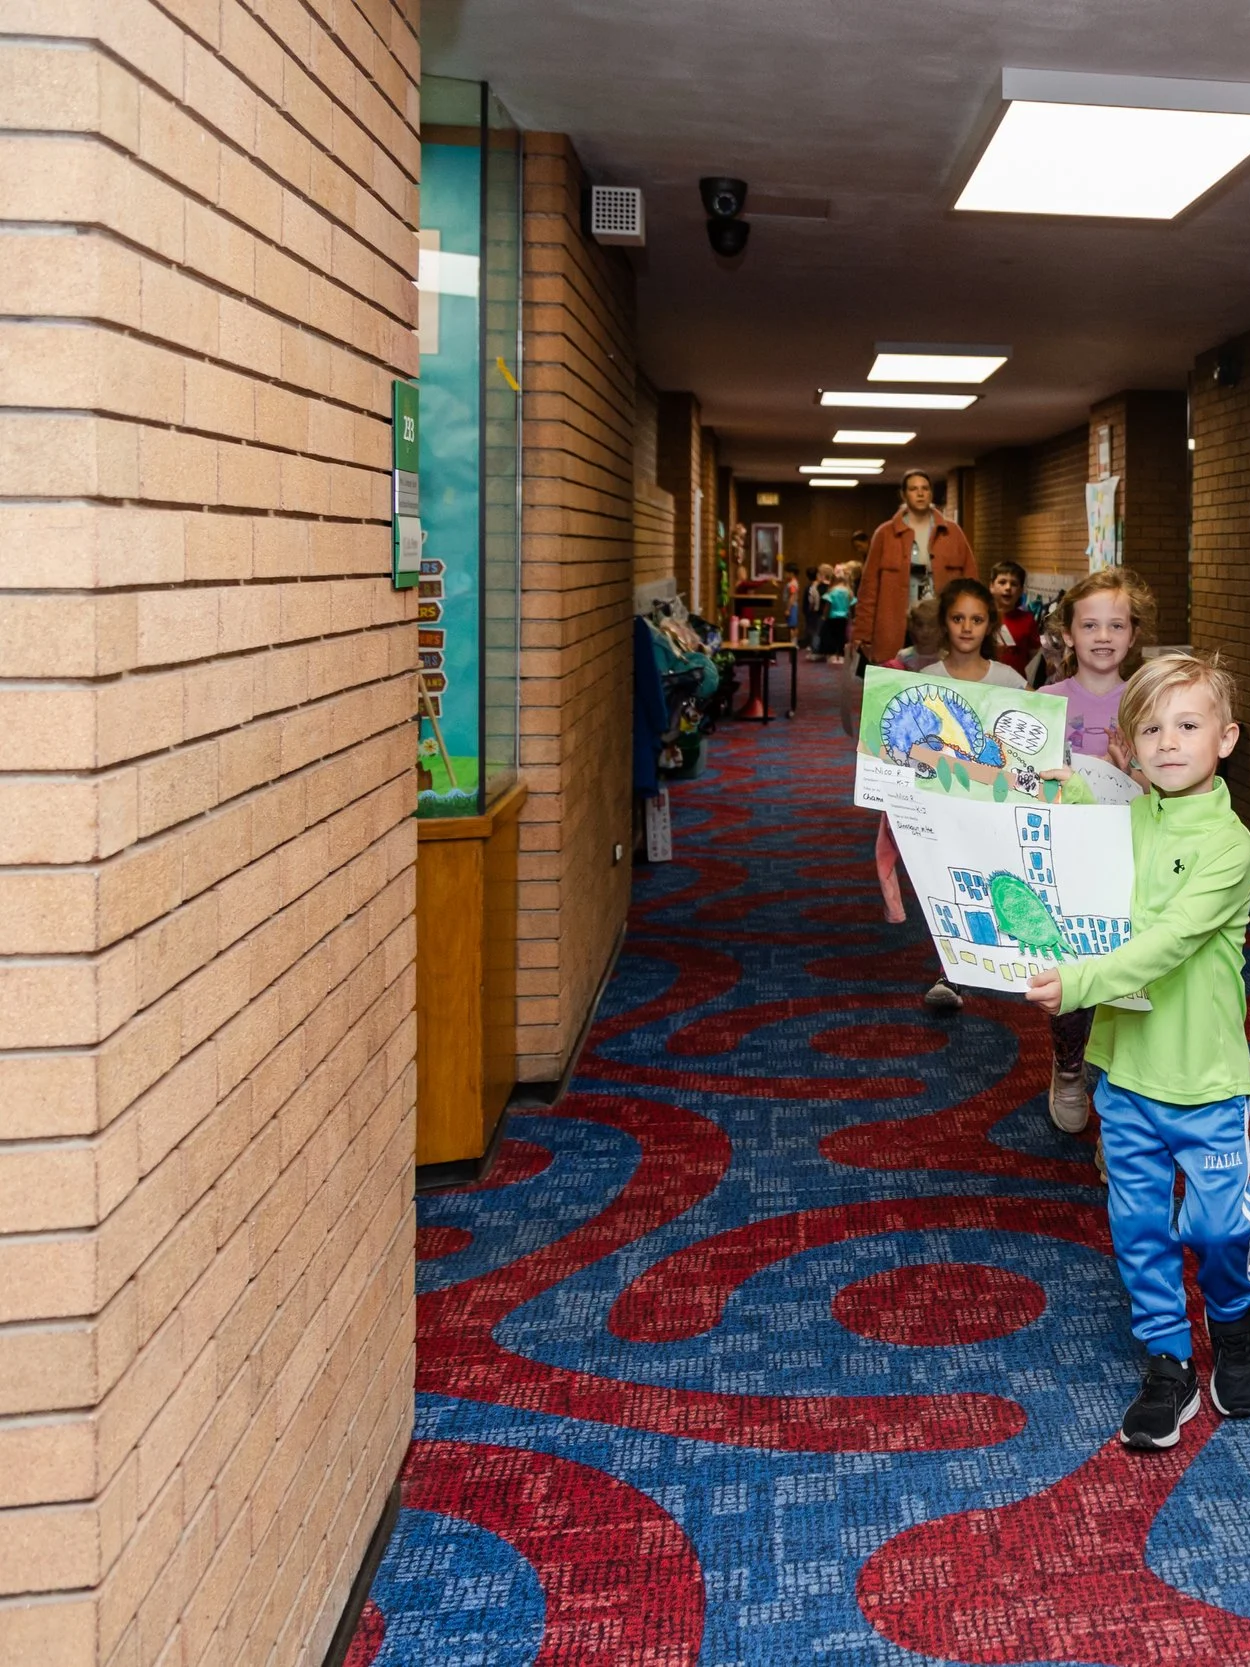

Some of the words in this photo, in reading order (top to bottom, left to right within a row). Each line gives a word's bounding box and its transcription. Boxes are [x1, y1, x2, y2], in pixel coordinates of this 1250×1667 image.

[403, 415, 414, 443] 233
[875, 766, 892, 776] Nico
[1203, 1151, 1243, 1169] ITALIA
